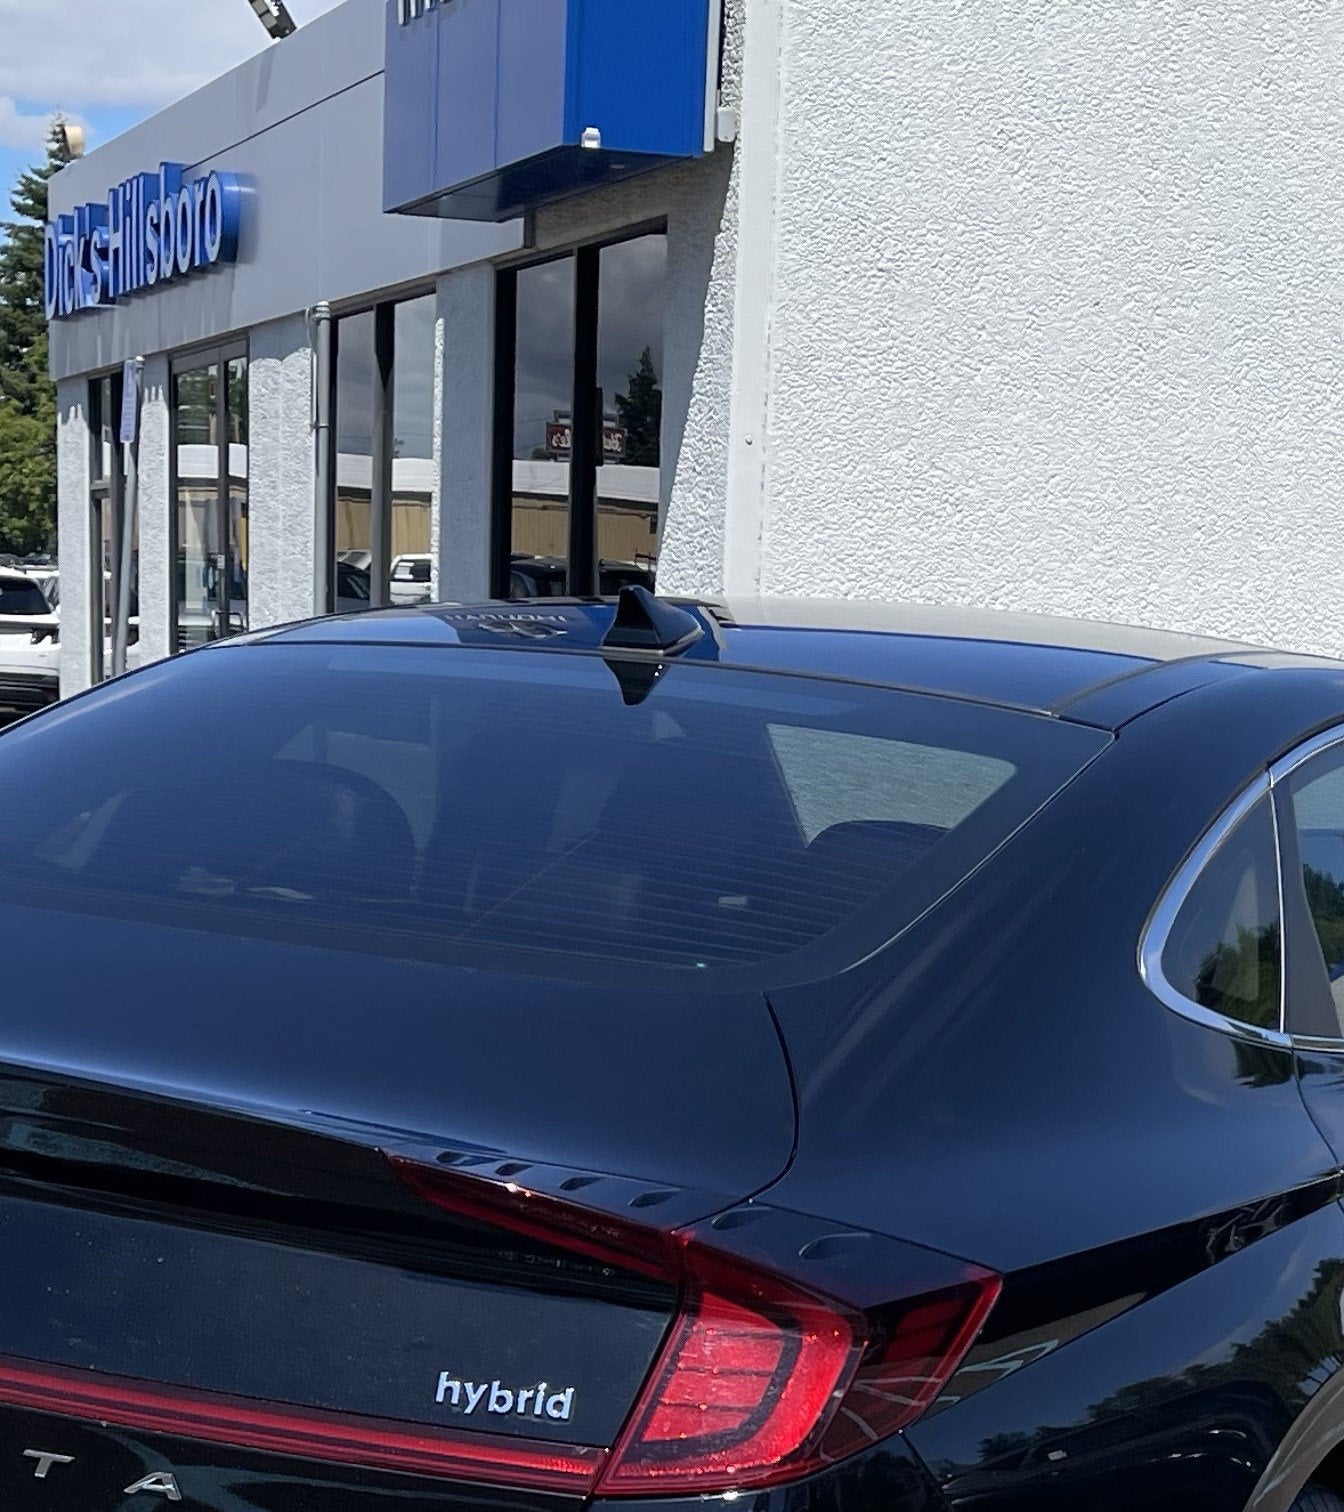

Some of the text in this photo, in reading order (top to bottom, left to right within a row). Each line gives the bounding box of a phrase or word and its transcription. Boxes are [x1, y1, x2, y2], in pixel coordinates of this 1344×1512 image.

[44, 161, 238, 321] Dick's Hillsboro
[435, 1371, 575, 1420] hybrid
